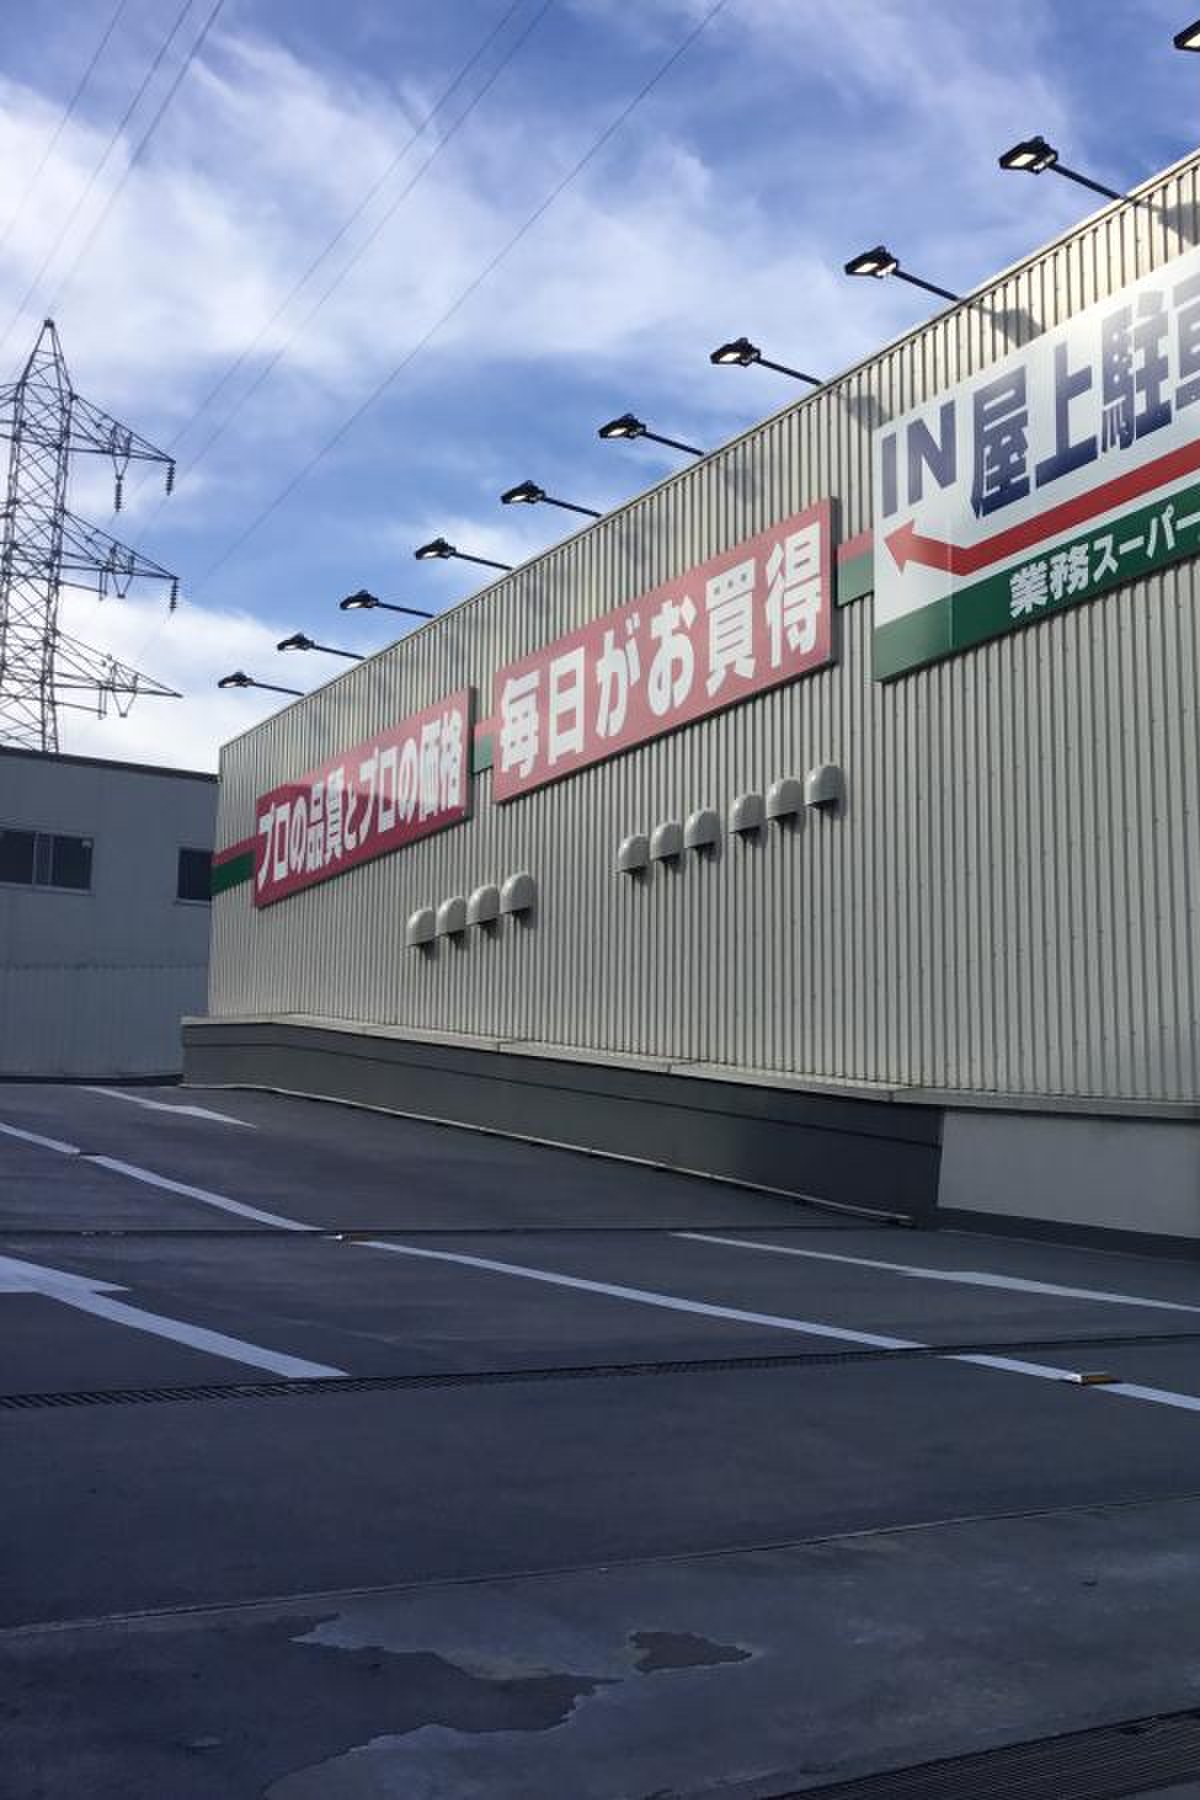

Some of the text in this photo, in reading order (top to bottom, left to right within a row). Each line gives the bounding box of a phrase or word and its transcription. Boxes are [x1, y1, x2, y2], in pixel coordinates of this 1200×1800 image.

[882, 400, 957, 517] IN
[500, 524, 823, 778] 毎日がお買得
[258, 709, 462, 892] プロの品質とプロの価格
